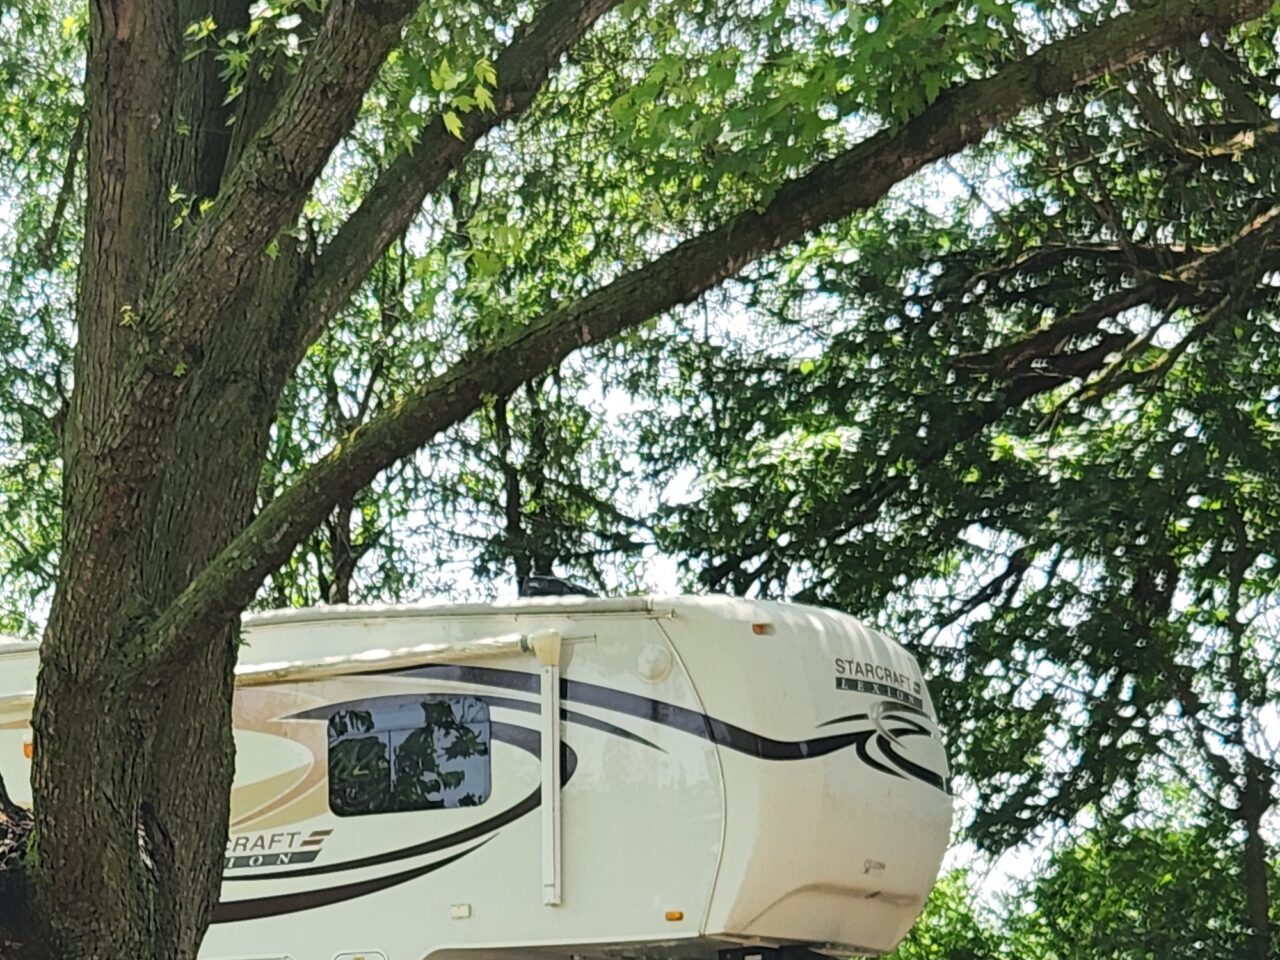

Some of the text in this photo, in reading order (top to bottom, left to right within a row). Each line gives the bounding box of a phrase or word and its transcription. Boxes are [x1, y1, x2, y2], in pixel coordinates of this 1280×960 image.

[835, 658, 911, 690] STARCRAFT
[841, 679, 914, 704] LEXION
[227, 853, 291, 868] ION
